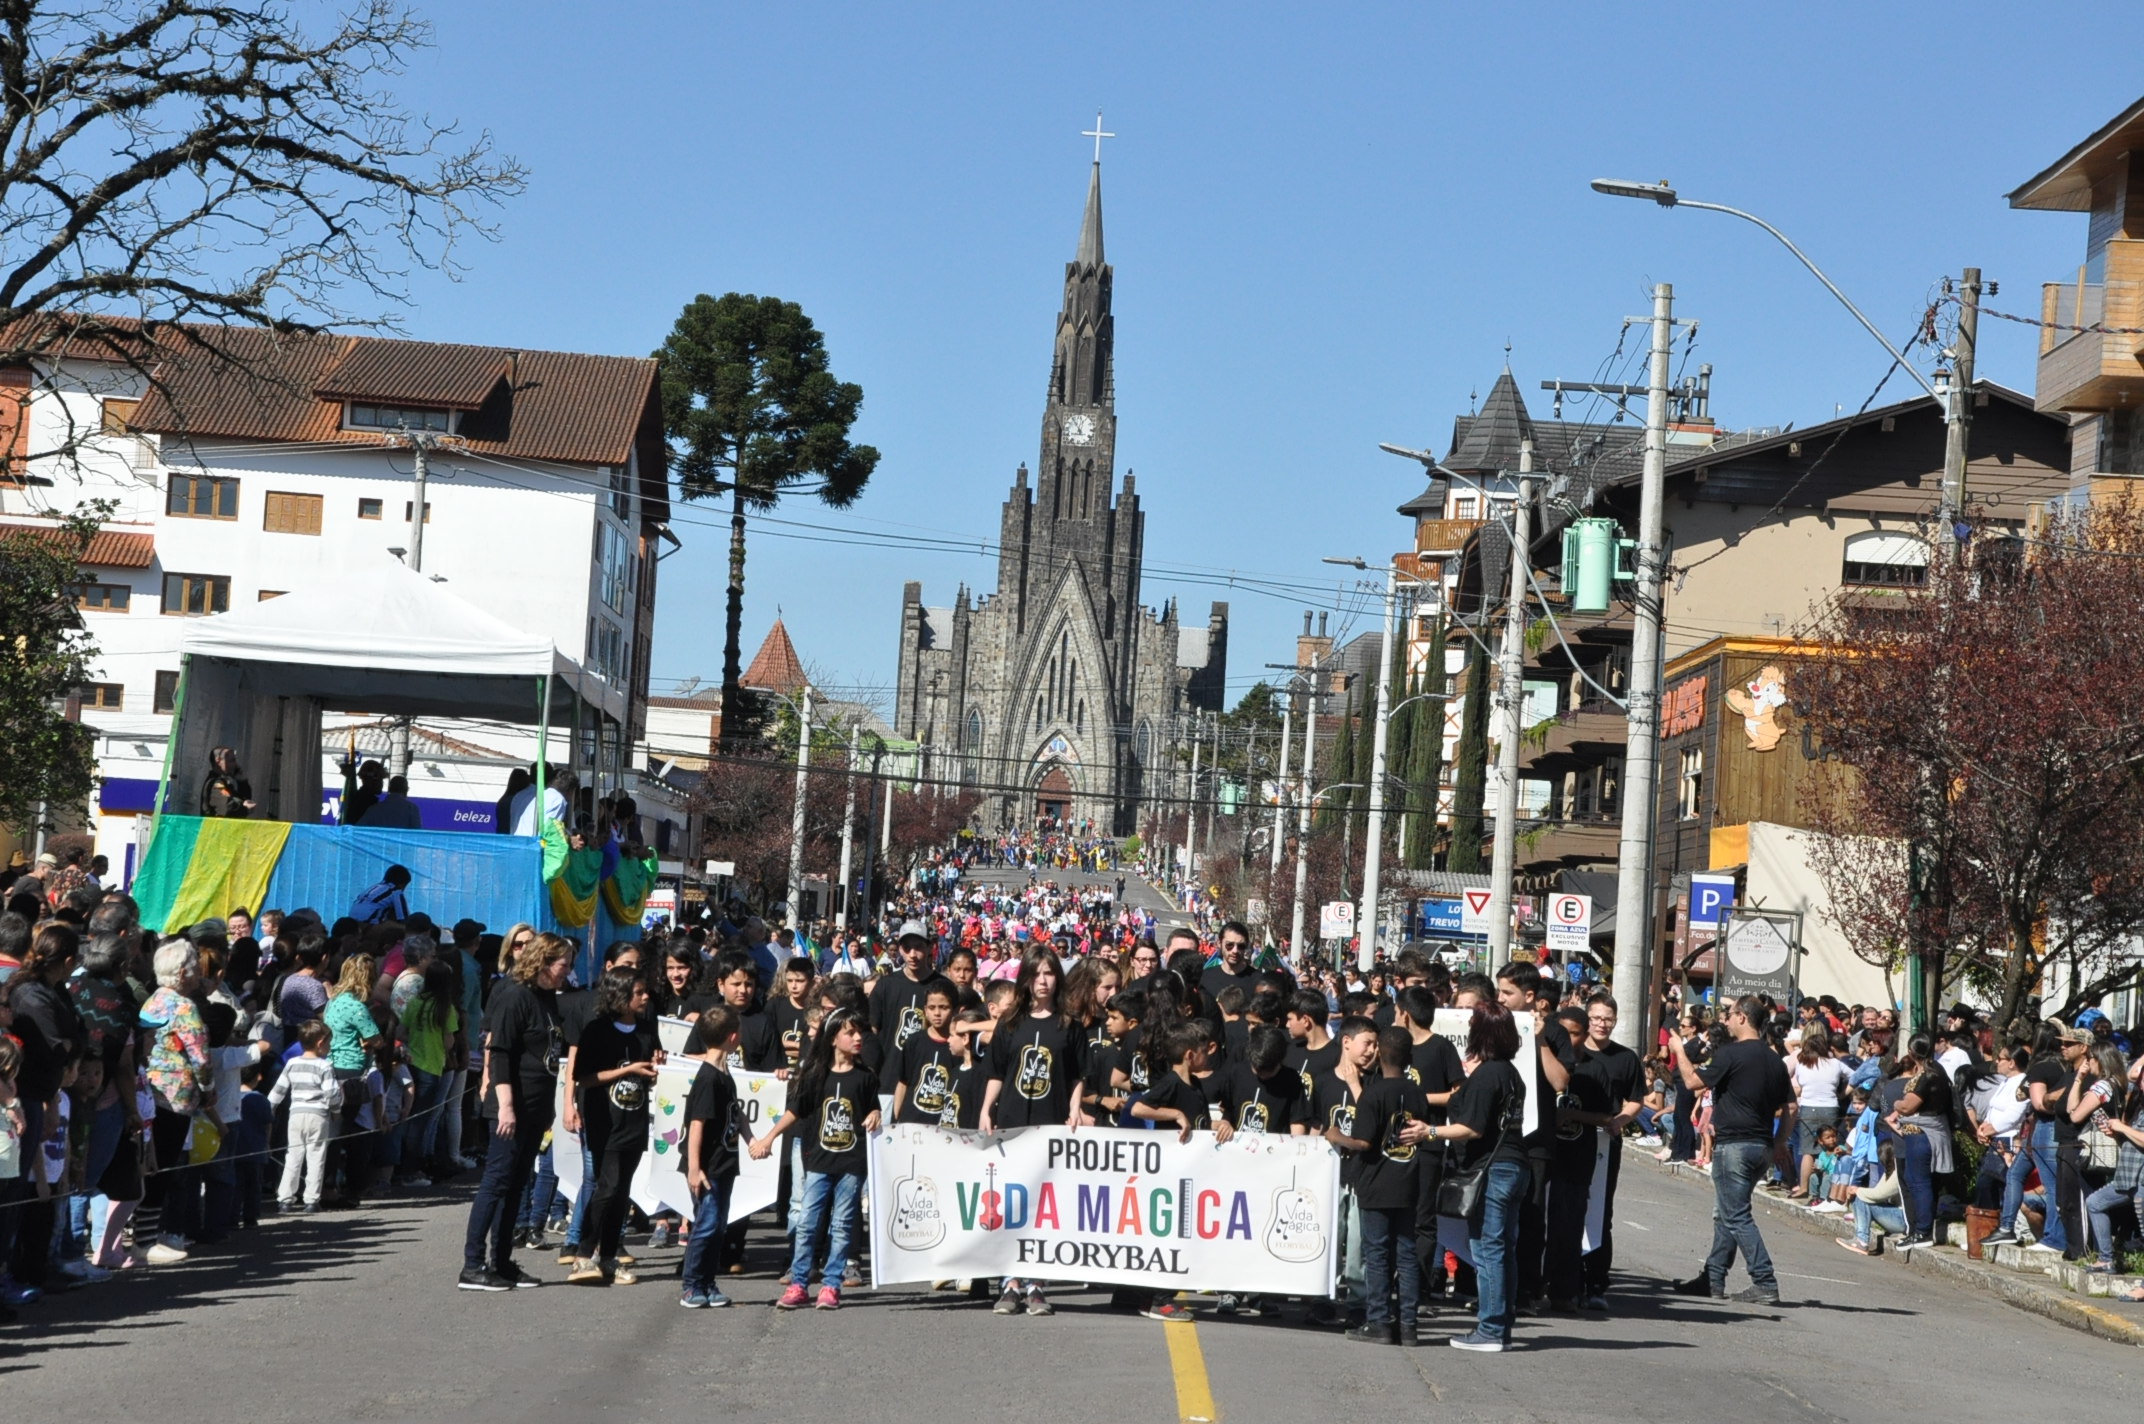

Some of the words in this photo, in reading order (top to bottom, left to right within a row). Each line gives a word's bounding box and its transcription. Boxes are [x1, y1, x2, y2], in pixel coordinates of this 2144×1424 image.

[453, 809, 491, 823] beleza
[1564, 901, 1577, 918] E
[1702, 889, 1720, 915] P
[1338, 906, 1346, 916] E
[1430, 917, 1460, 928] TREVO
[1676, 959, 1709, 970] Hpital
[1729, 975, 1743, 985] Ao
[1744, 977, 1767, 987] meio
[1768, 979, 1782, 989] dia
[928, 1073, 944, 1088] Vida
[830, 1106, 850, 1122] Vida
[1248, 1112, 1264, 1128] Vida
[1337, 1113, 1352, 1130] Vid
[1048, 1138, 1161, 1174] PROJETO
[905, 1187, 933, 1209] Vida
[1078, 1176, 1252, 1240] MÁGICA
[1285, 1199, 1313, 1221] Vida
[898, 1231, 935, 1239] FLORYBAL
[1017, 1239, 1189, 1274] FLORYBAL
